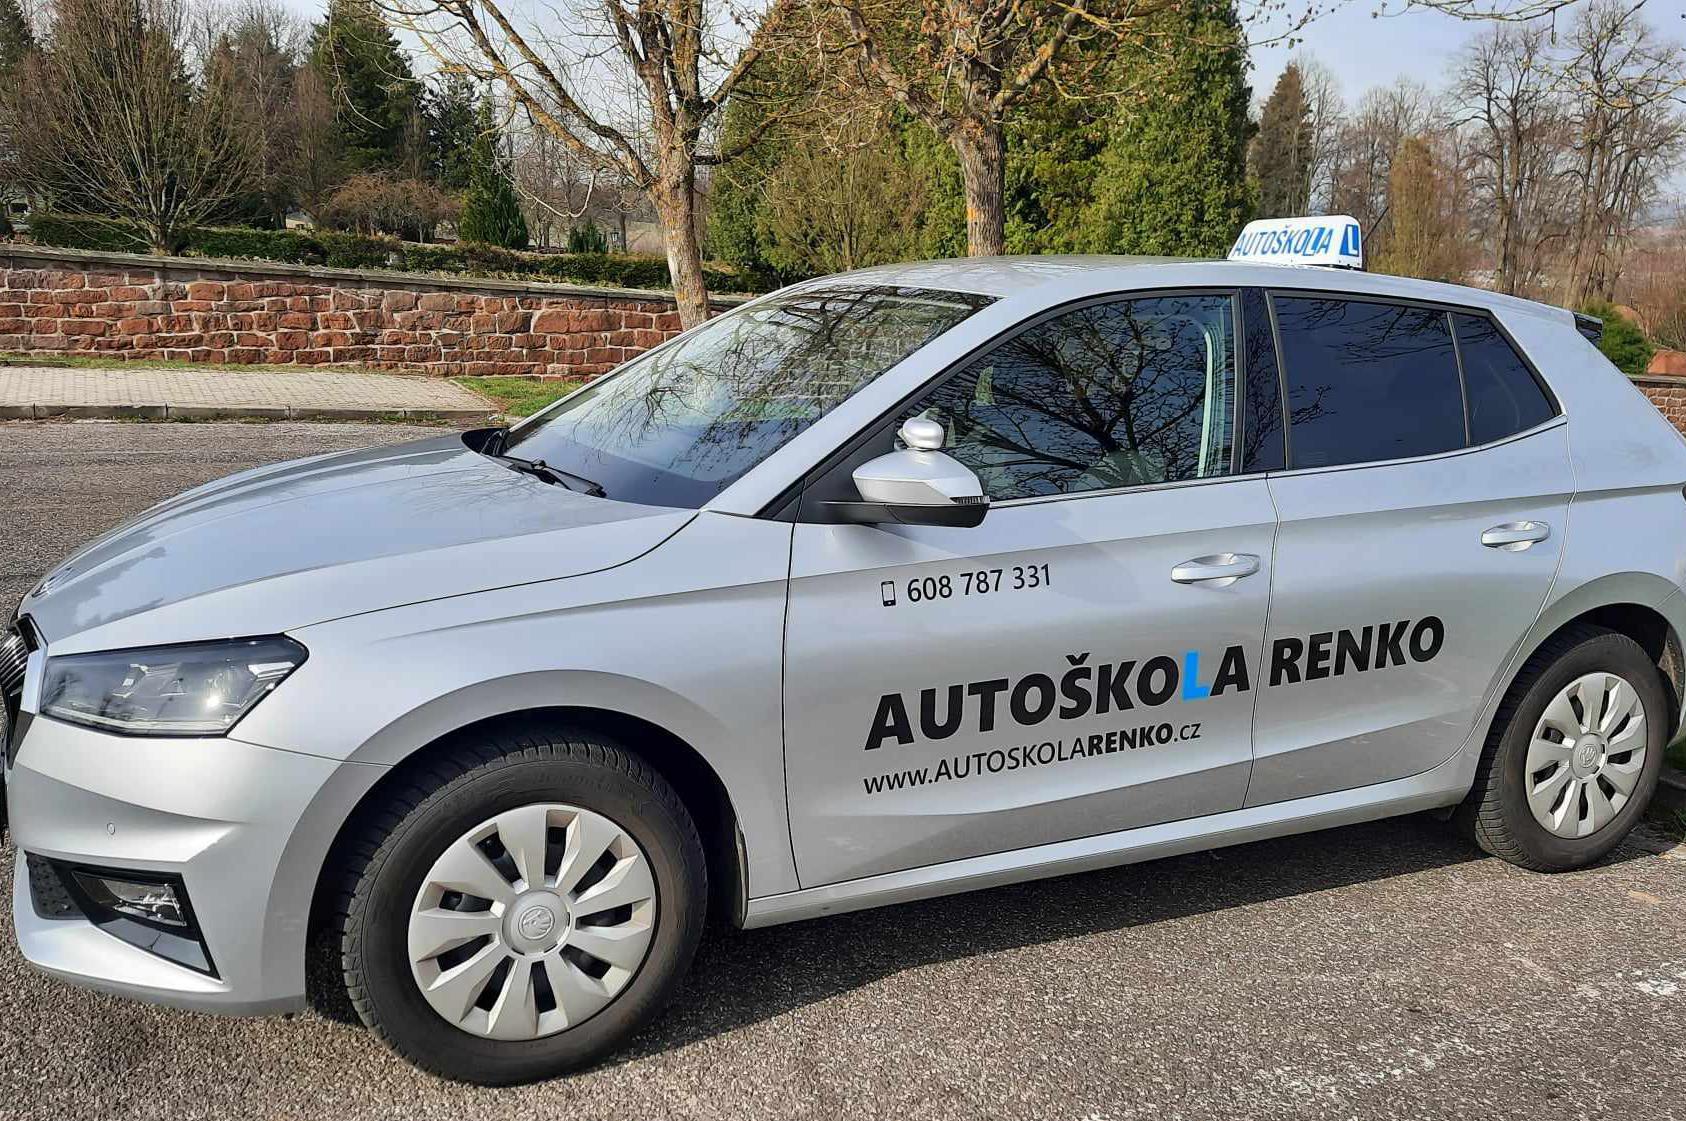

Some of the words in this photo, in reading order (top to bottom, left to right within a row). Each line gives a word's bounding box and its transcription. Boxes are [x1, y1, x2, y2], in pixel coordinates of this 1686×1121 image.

[907, 573, 953, 603] 608
[960, 568, 1004, 597] 787
[1012, 563, 1051, 591] 331
[864, 645, 1251, 750] AUTOŠKOLA
[1269, 615, 1445, 687] RENKO
